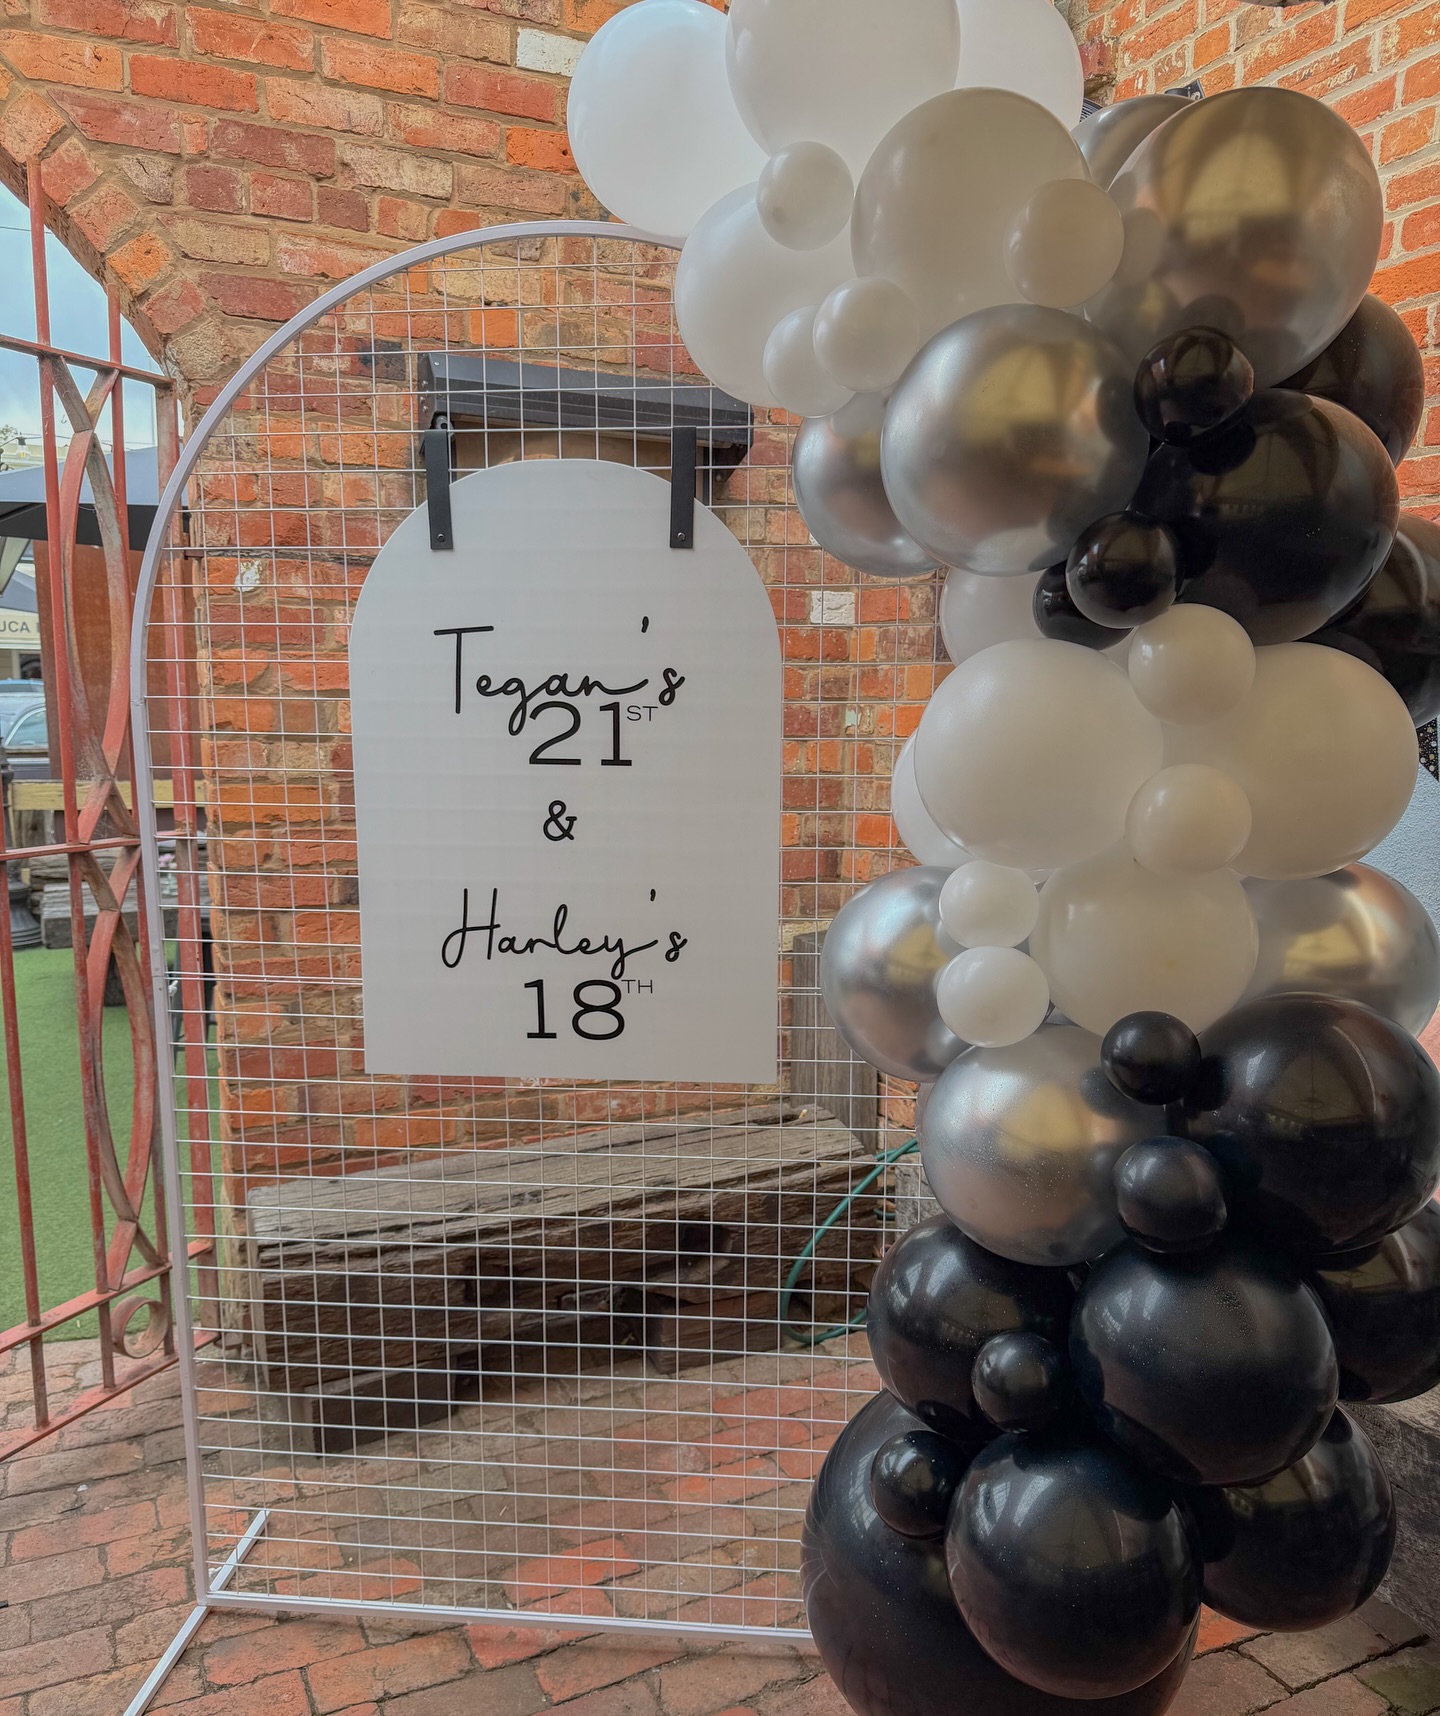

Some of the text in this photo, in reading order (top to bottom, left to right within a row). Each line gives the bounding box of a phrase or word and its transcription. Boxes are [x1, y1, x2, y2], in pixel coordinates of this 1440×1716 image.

[433, 615, 686, 737] Tegan's
[542, 799, 578, 842] &
[441, 887, 689, 981] Harley's
